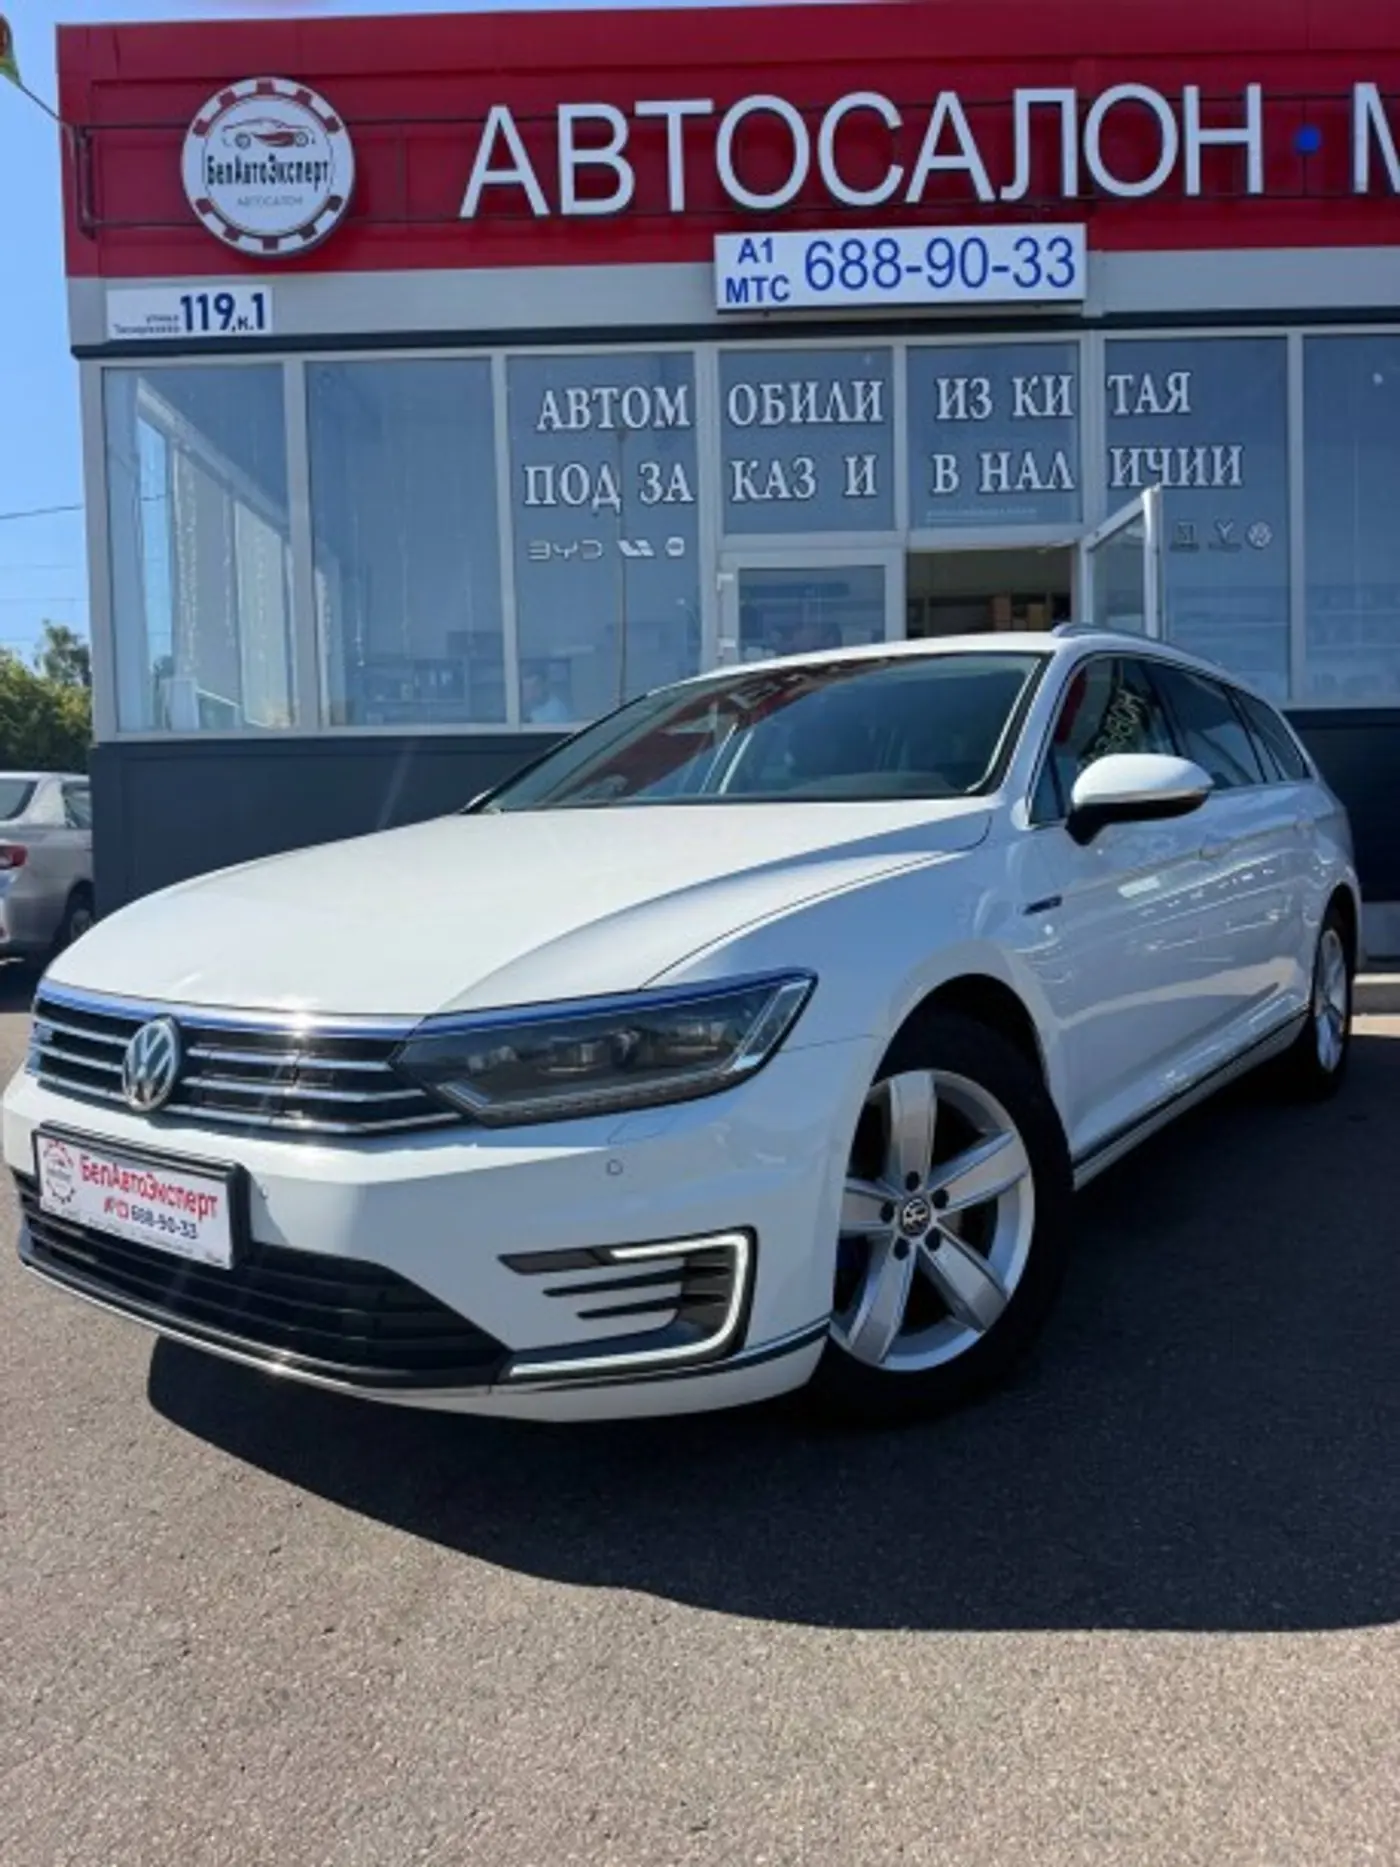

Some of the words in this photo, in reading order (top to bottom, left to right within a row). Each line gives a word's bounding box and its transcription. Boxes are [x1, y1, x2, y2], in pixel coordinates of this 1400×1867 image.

[207, 154, 328, 192] БелАвтоЭксперт
[458, 82, 1264, 219] АВТОСАЛОН
[804, 236, 1076, 292] 688-90-33
[725, 275, 790, 304] МТС
[936, 378, 993, 420] ИЗ
[524, 463, 622, 513] ПОД
[844, 455, 877, 497] И
[933, 453, 960, 493] В
